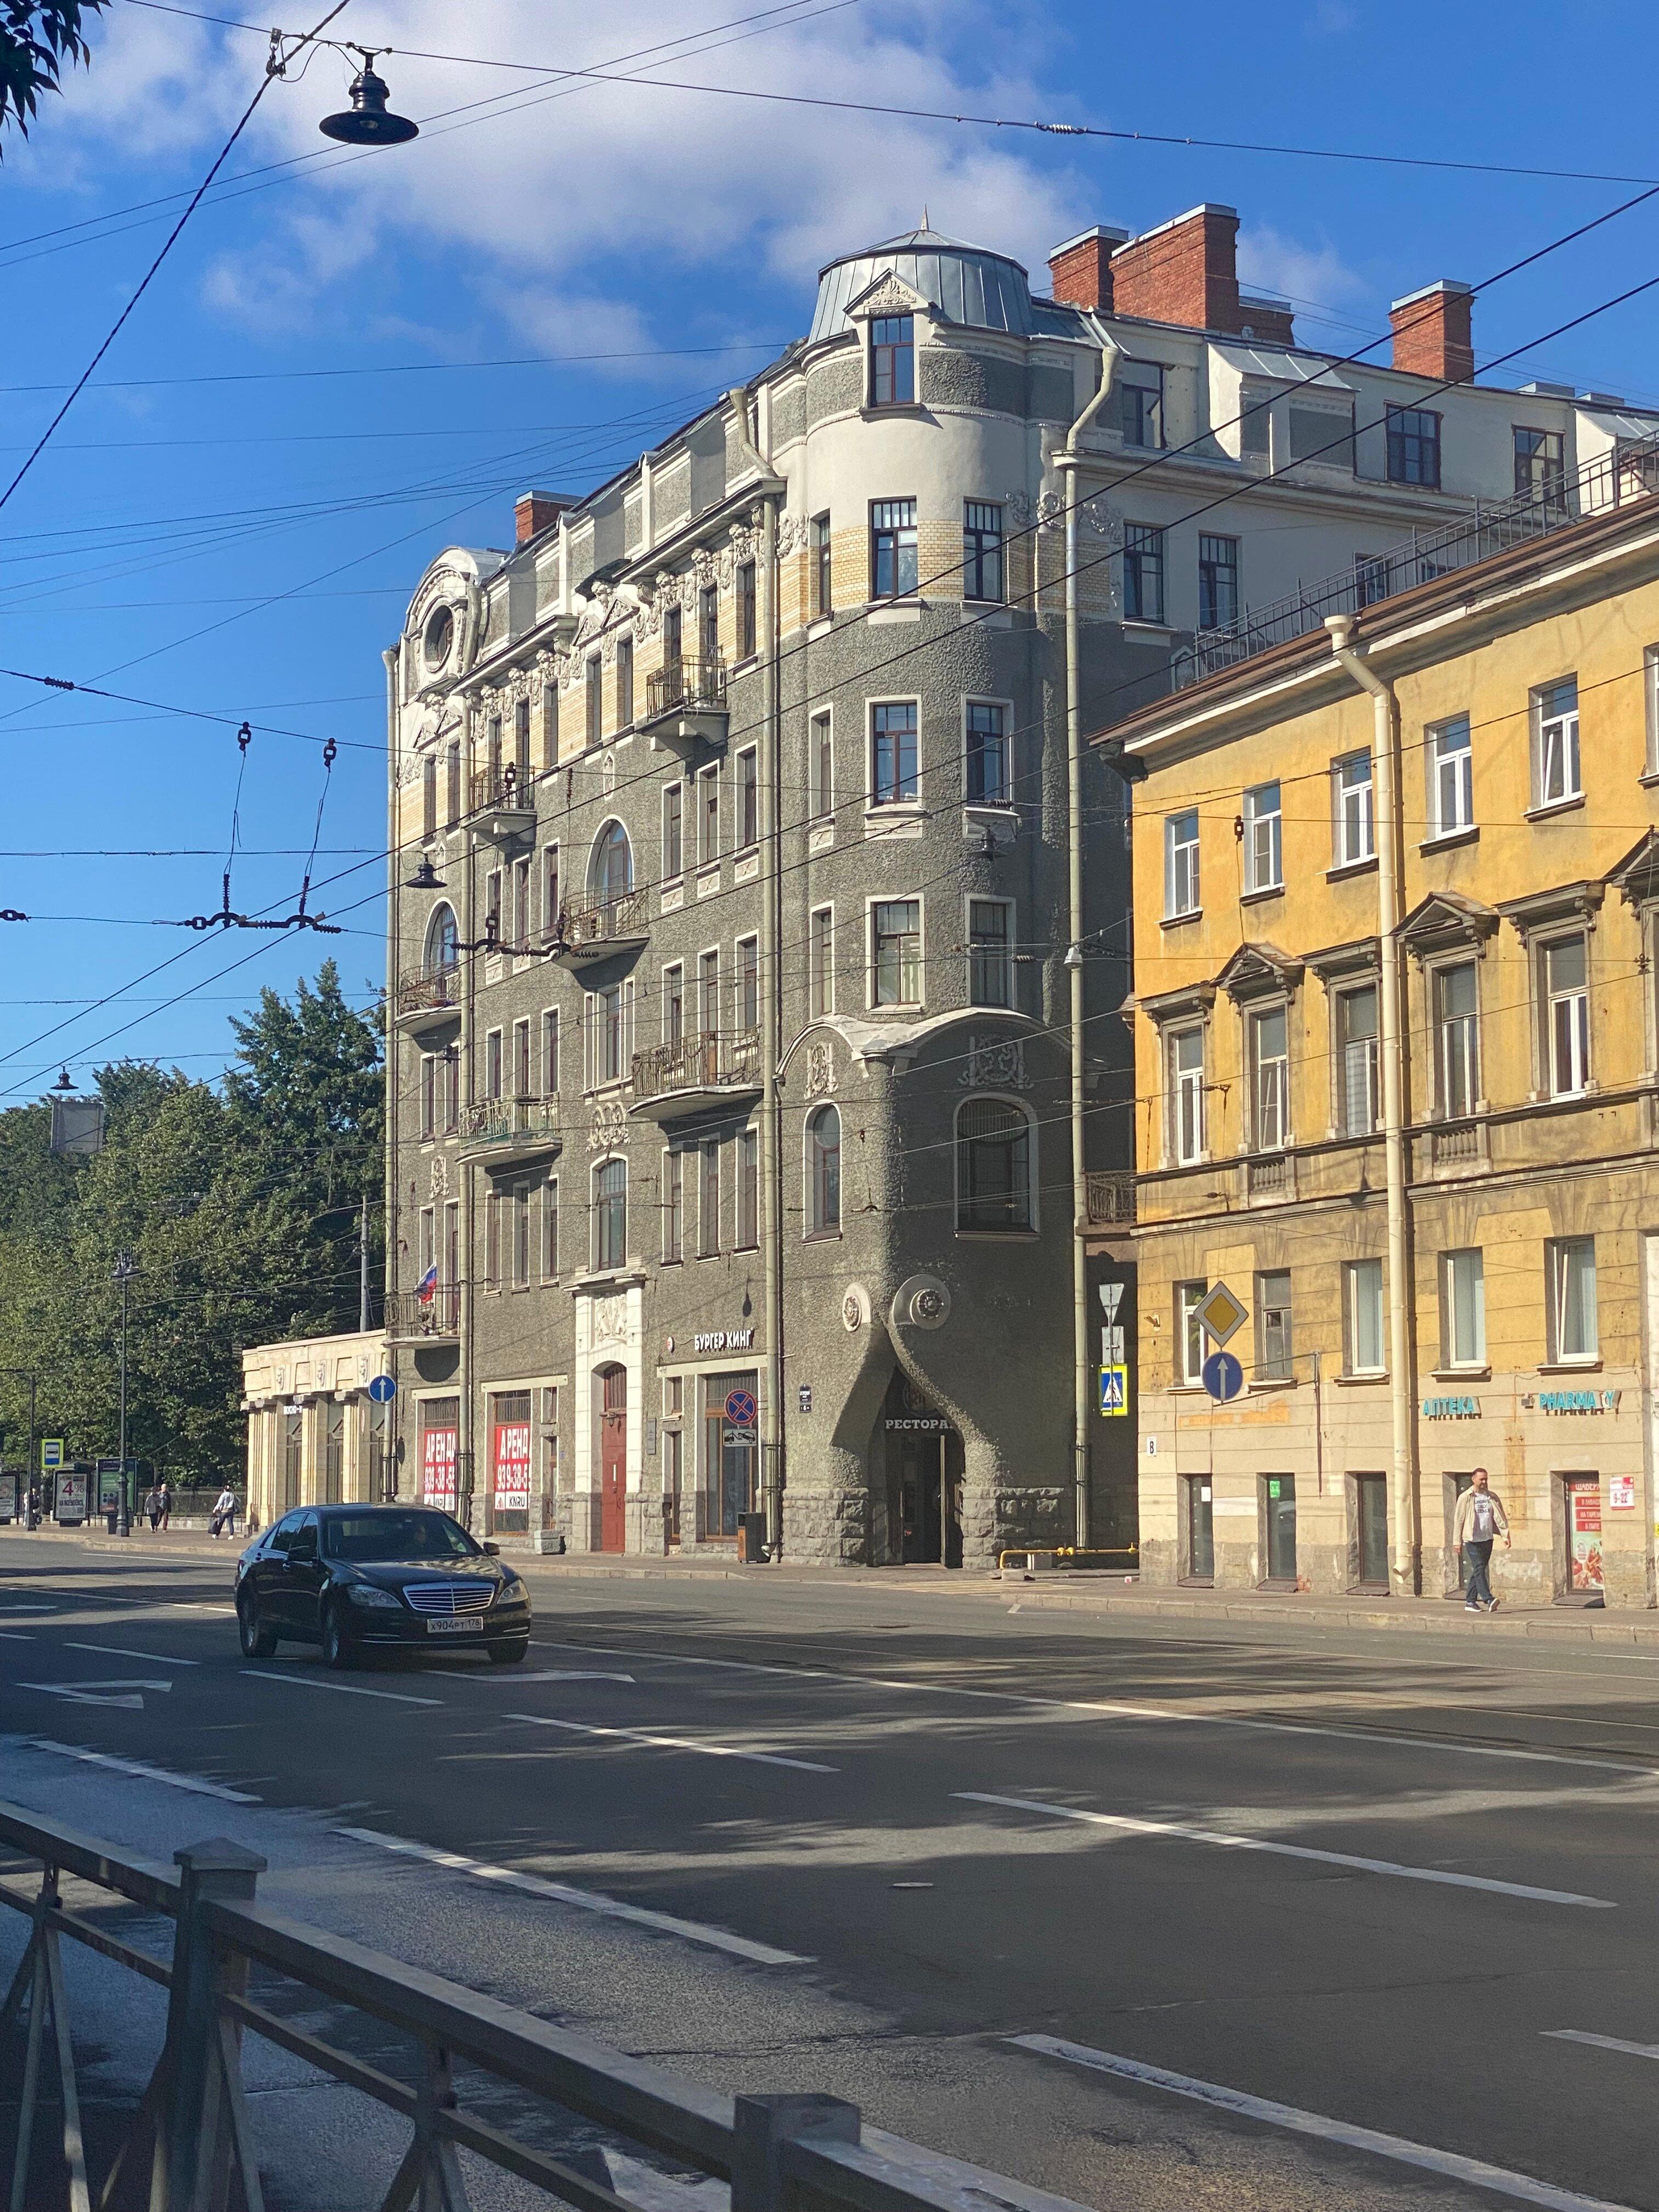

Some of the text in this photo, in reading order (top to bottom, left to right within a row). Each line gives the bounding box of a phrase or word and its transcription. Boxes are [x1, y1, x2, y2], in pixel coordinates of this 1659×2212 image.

[695, 1330, 752, 1350] БУРГЕР КИНГ
[1423, 1396, 1474, 1415] АПТЕКА
[885, 1419, 954, 1429] РЕСТОРА
[500, 1428, 528, 1460] АРЕНД
[498, 1463, 528, 1491] 939-38-5
[509, 1496, 525, 1507] KNRU
